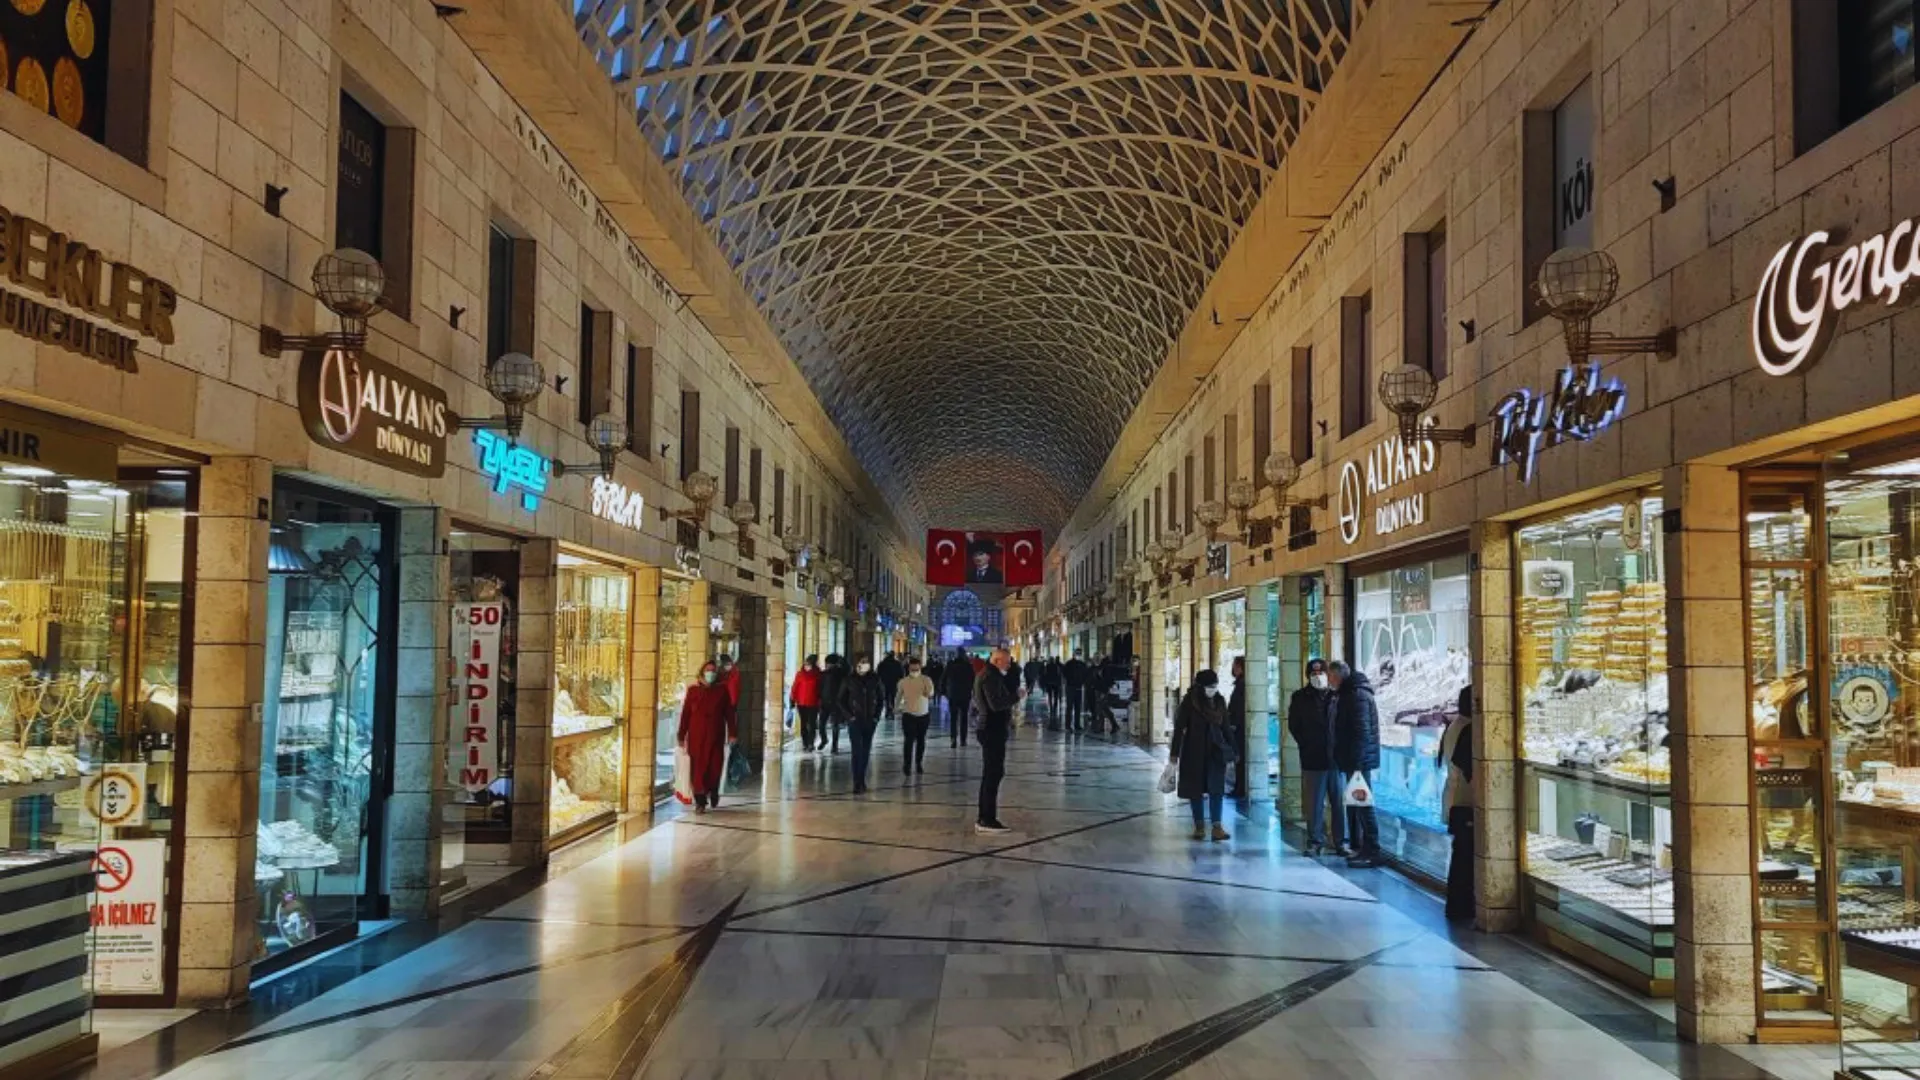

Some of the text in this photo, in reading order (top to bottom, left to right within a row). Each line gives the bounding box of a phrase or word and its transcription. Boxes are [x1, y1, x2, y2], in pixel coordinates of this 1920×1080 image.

[1753, 219, 1920, 376] Genç
[361, 368, 446, 438] ALYANS
[376, 425, 432, 467] DÜNYASI
[1367, 416, 1435, 497] ALYANS
[1376, 492, 1424, 535] DÜNYASI
[455, 606, 499, 625] %50
[459, 639, 490, 785] İNDİRİM
[109, 900, 156, 928] İÇİLMEZ
